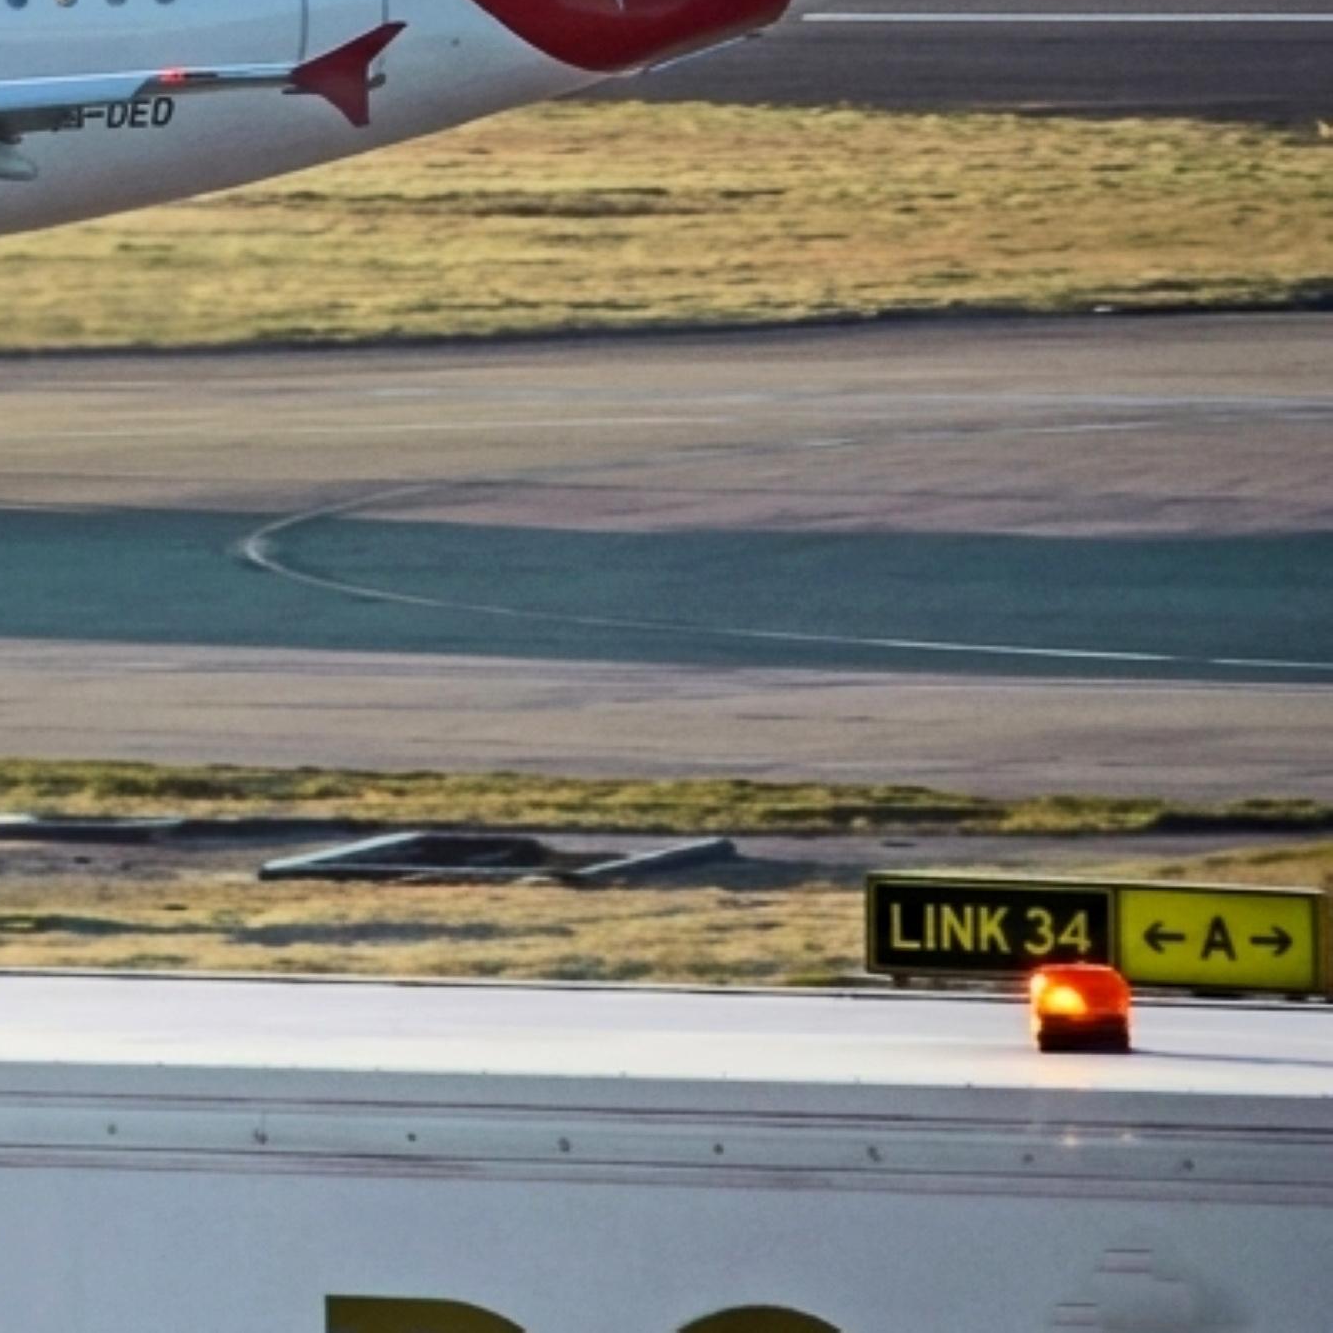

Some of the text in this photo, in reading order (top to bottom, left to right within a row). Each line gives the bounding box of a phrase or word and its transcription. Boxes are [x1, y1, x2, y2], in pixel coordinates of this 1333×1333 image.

[890, 902, 1091, 956] LINK 34
[1200, 916, 1238, 962] A
